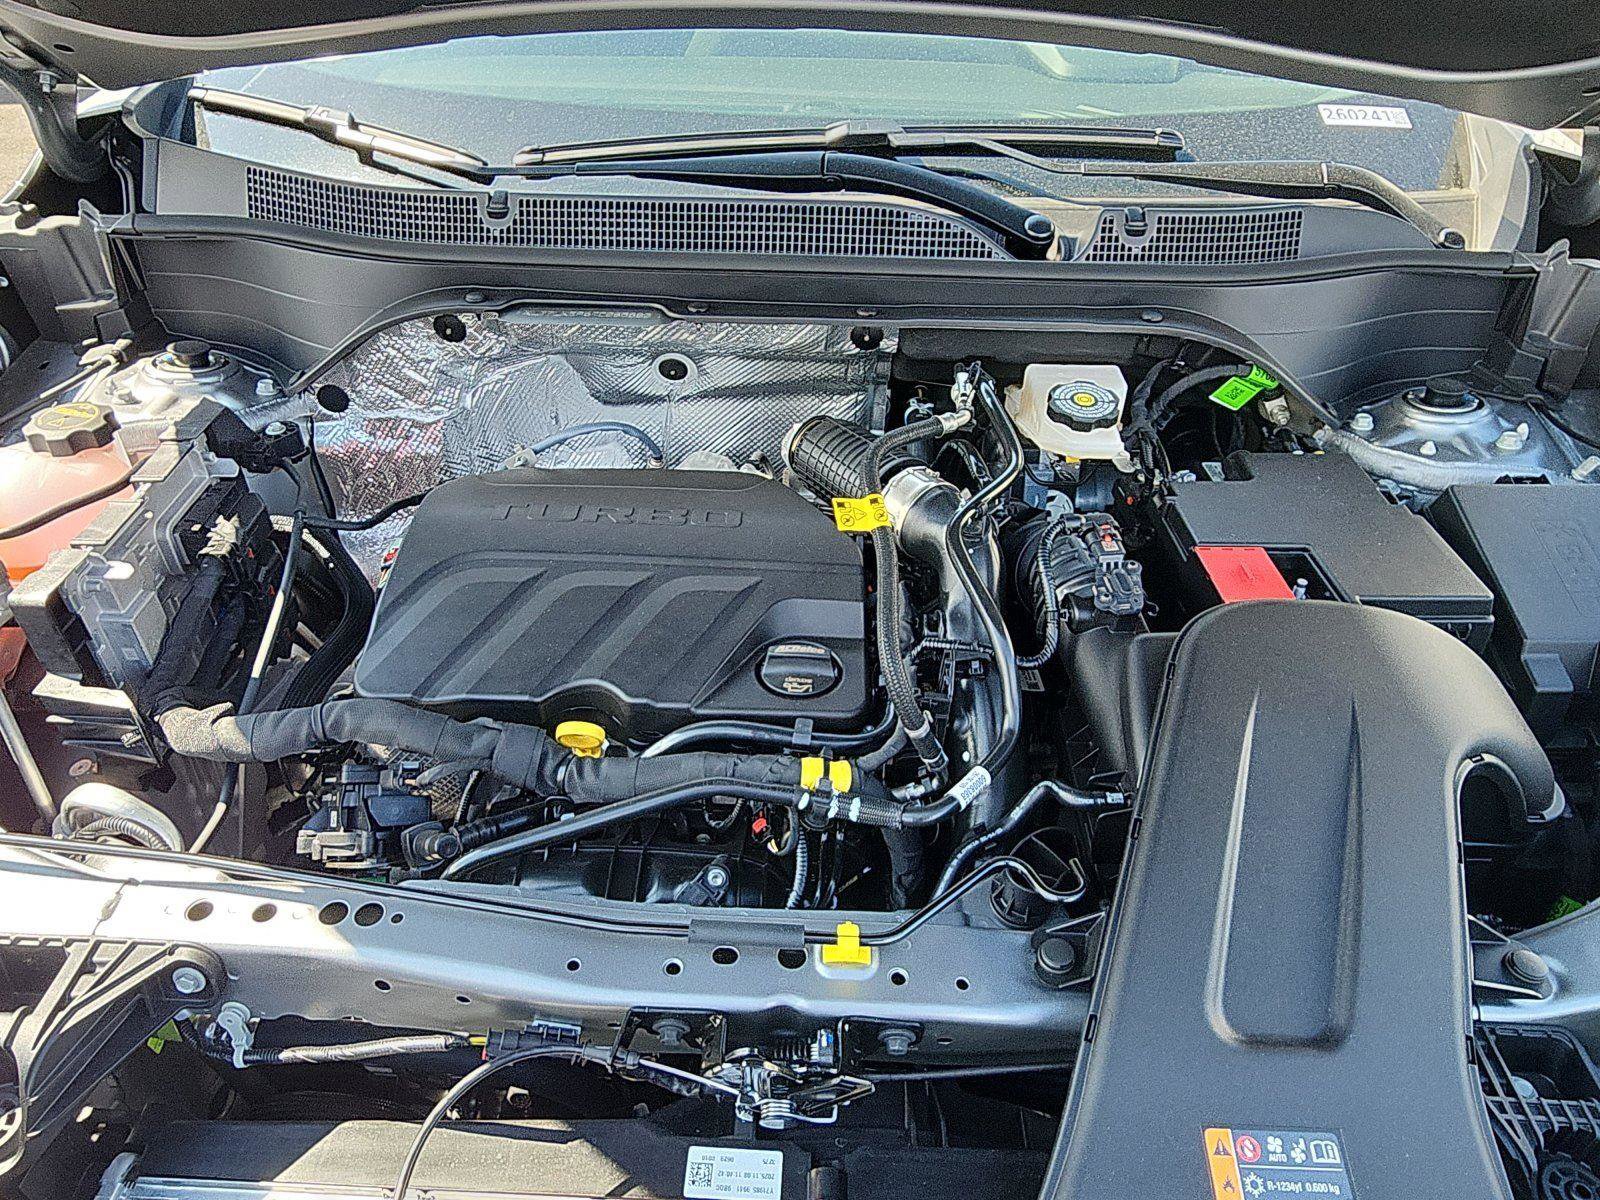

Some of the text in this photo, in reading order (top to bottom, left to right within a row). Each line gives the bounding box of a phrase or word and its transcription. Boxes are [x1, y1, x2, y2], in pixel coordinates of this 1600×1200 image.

[490, 503, 744, 528] TURBO
[1268, 1153, 1287, 1163] AUTO
[1328, 1183, 1340, 1195] kg
